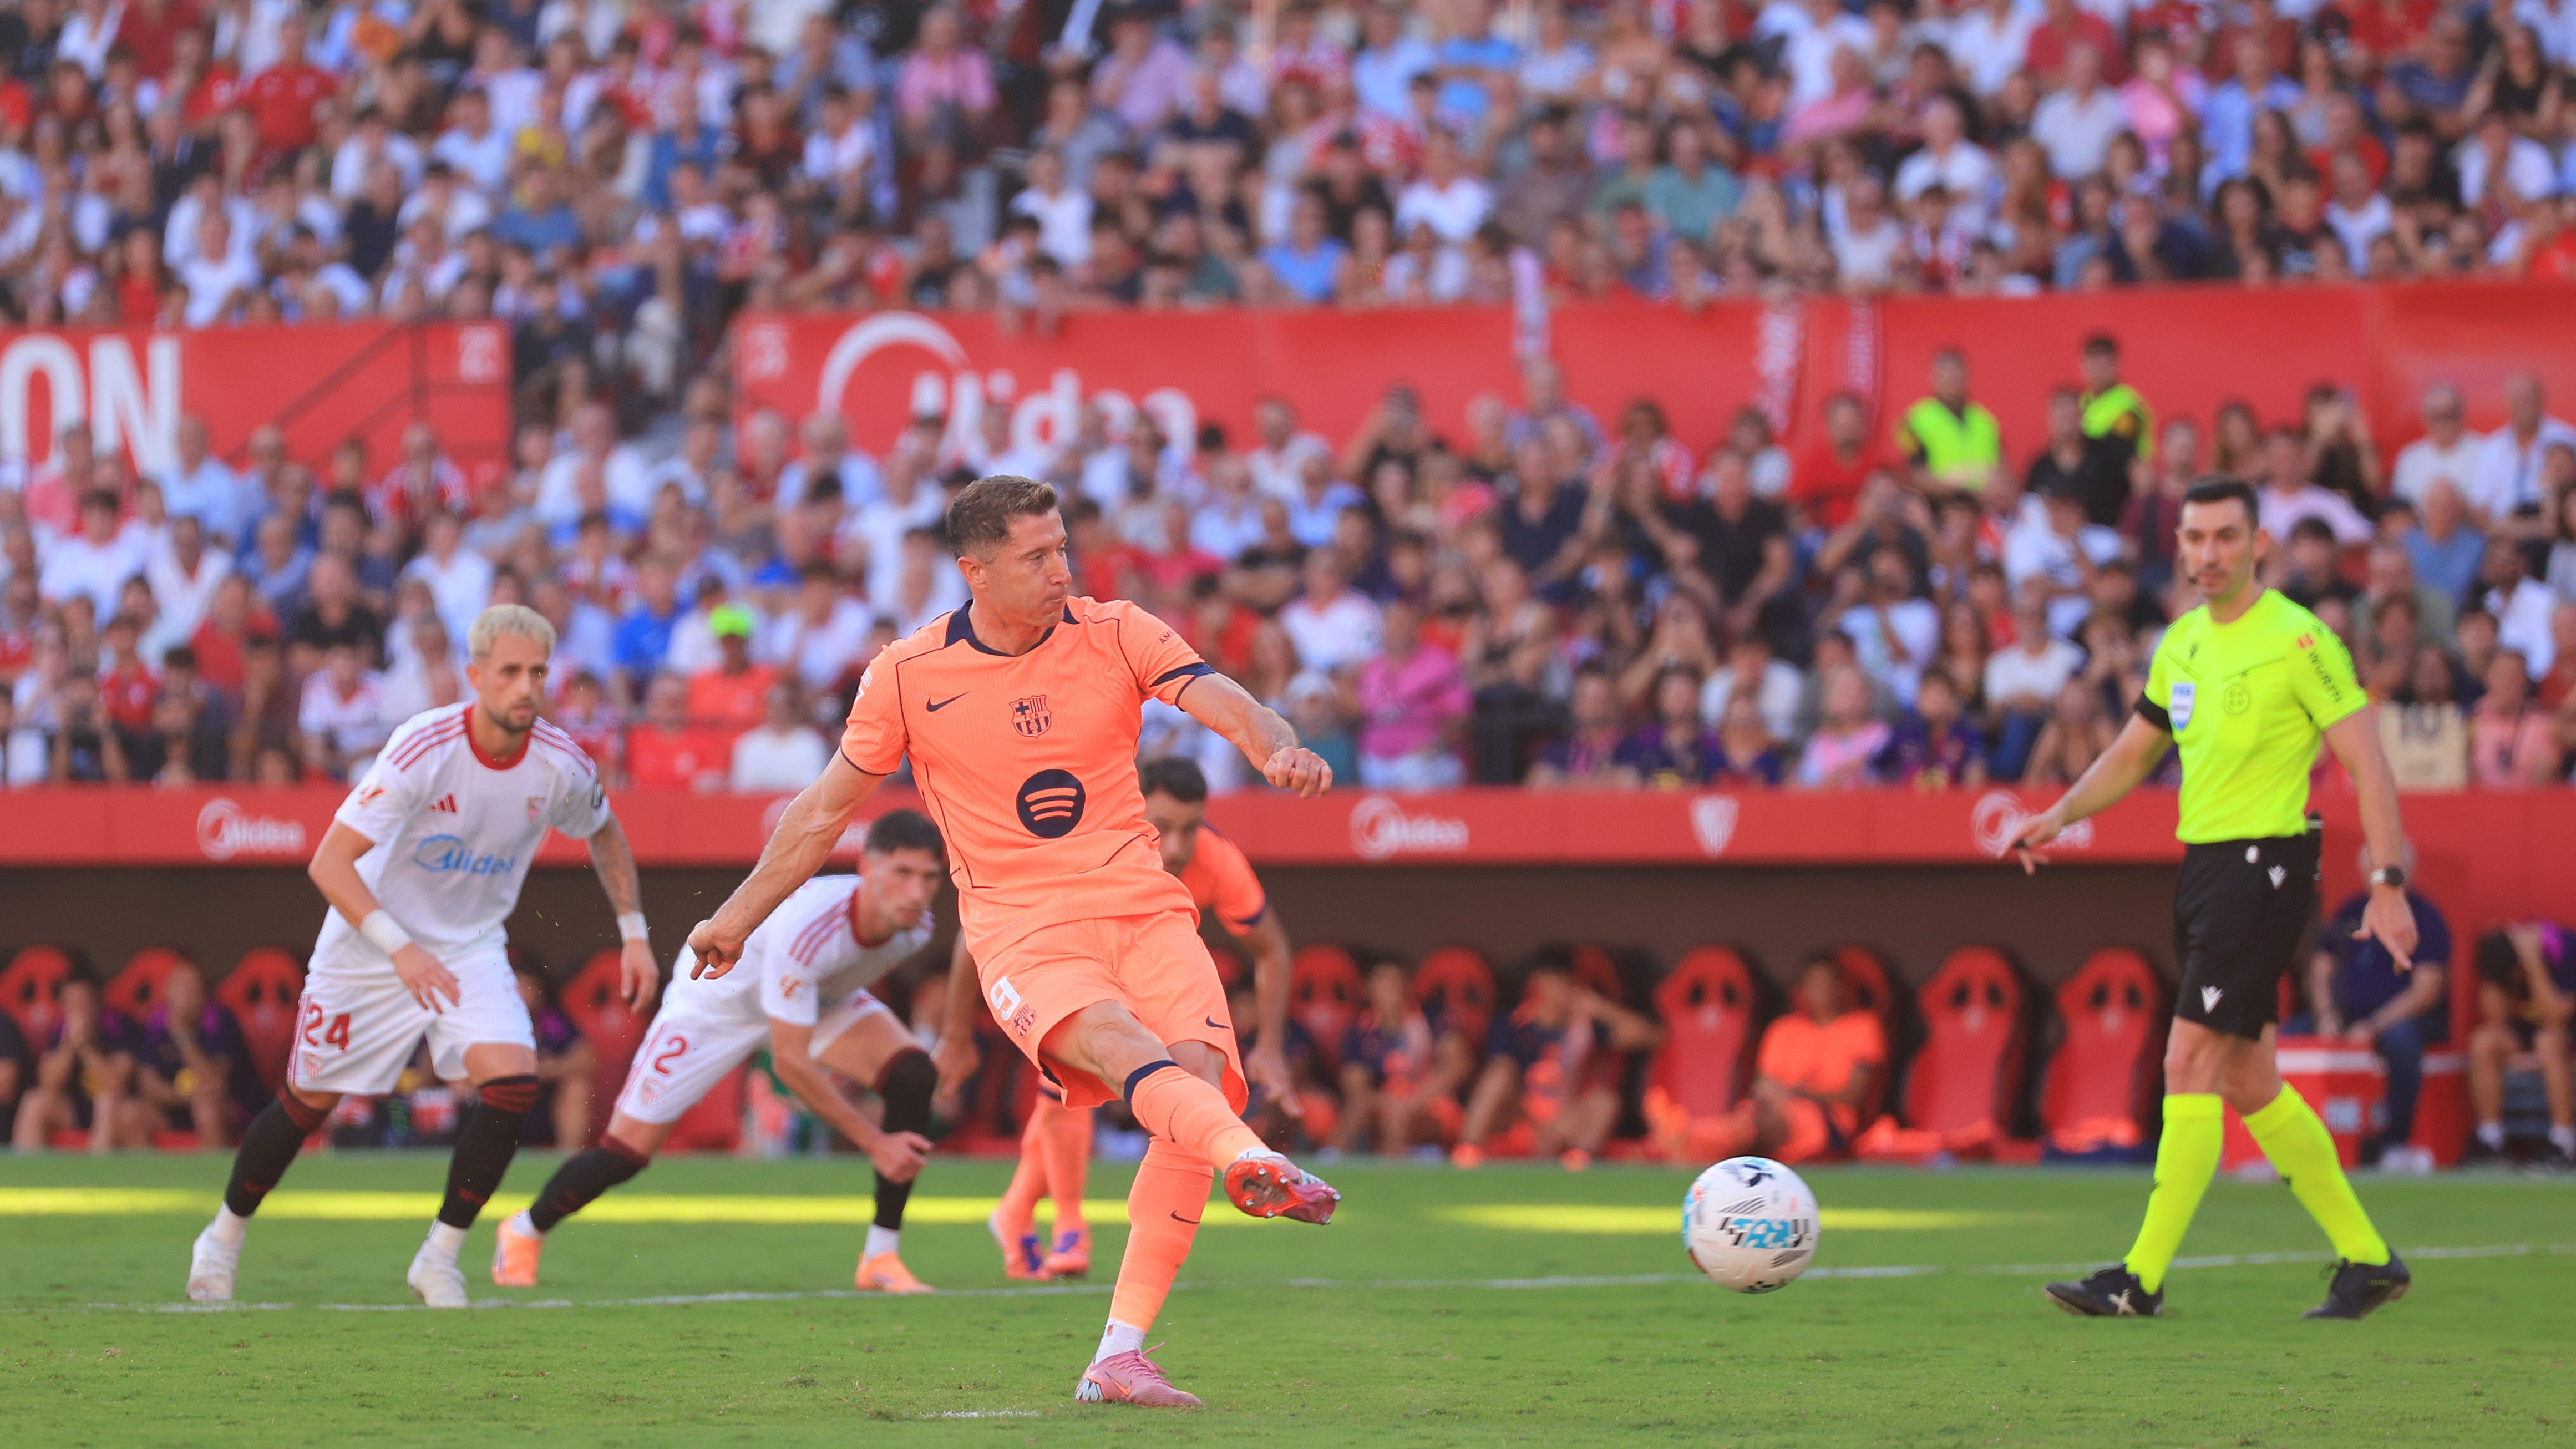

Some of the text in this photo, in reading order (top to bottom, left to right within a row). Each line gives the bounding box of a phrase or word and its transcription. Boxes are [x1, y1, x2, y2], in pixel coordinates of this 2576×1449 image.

[990, 976, 1021, 1021] 9
[306, 1004, 351, 1051] 24
[654, 1036, 687, 1075] 2
